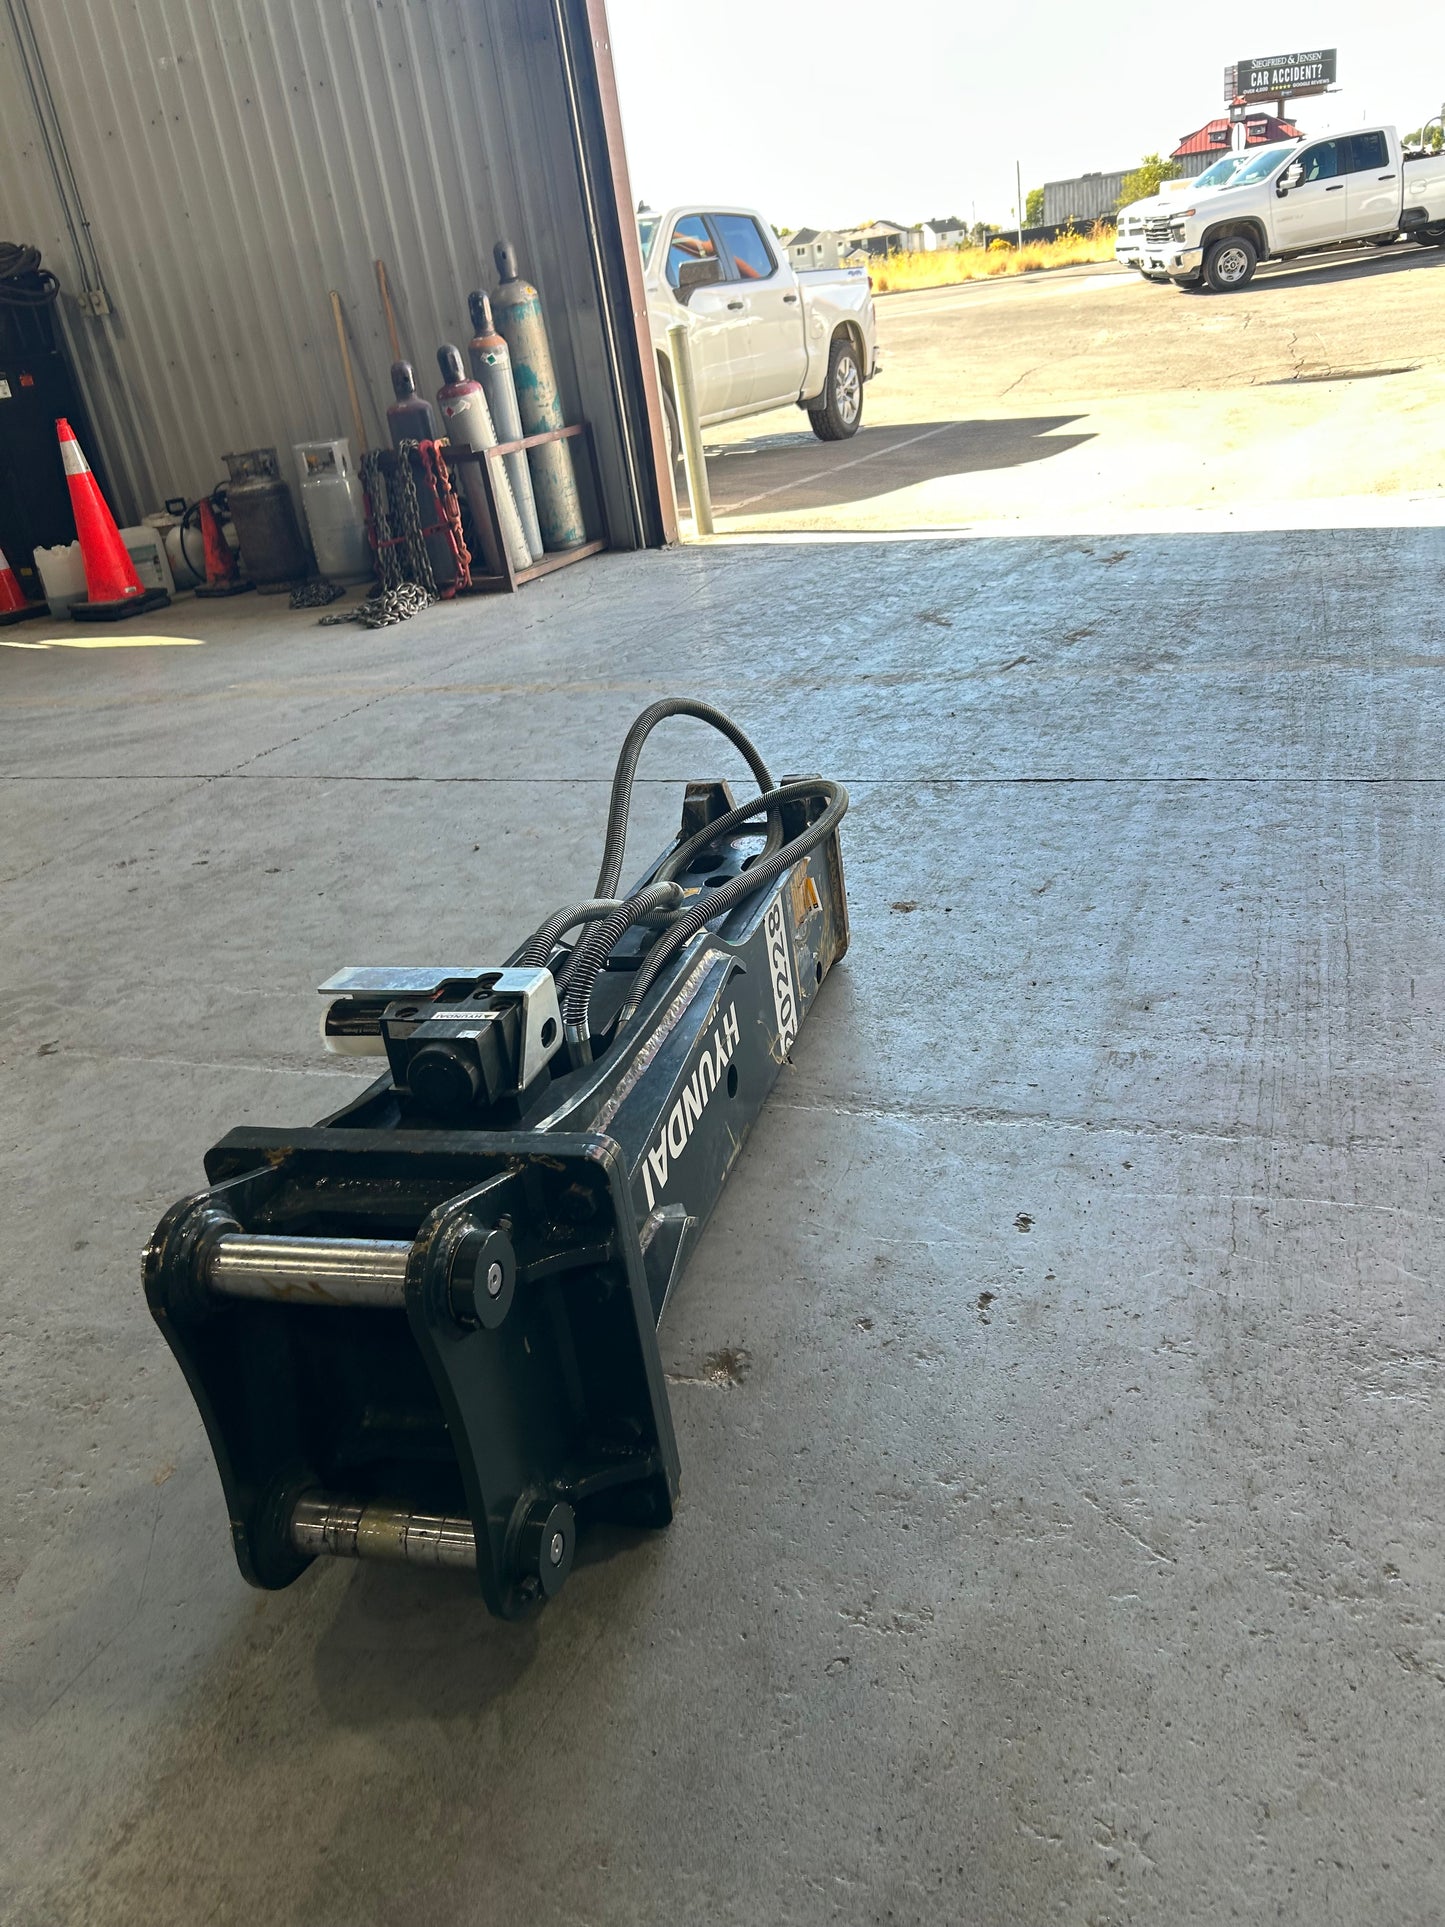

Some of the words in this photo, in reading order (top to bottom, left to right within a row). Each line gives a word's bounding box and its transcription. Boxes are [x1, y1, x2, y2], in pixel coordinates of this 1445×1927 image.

[1251, 57, 1287, 69] SIEGFRIED
[1287, 54, 1295, 65] &
[1296, 52, 1322, 64] JENSEN
[1251, 71, 1269, 86] CAR
[1272, 64, 1322, 83] ACCIDENT?
[641, 1000, 741, 1212] HYUNDAI
